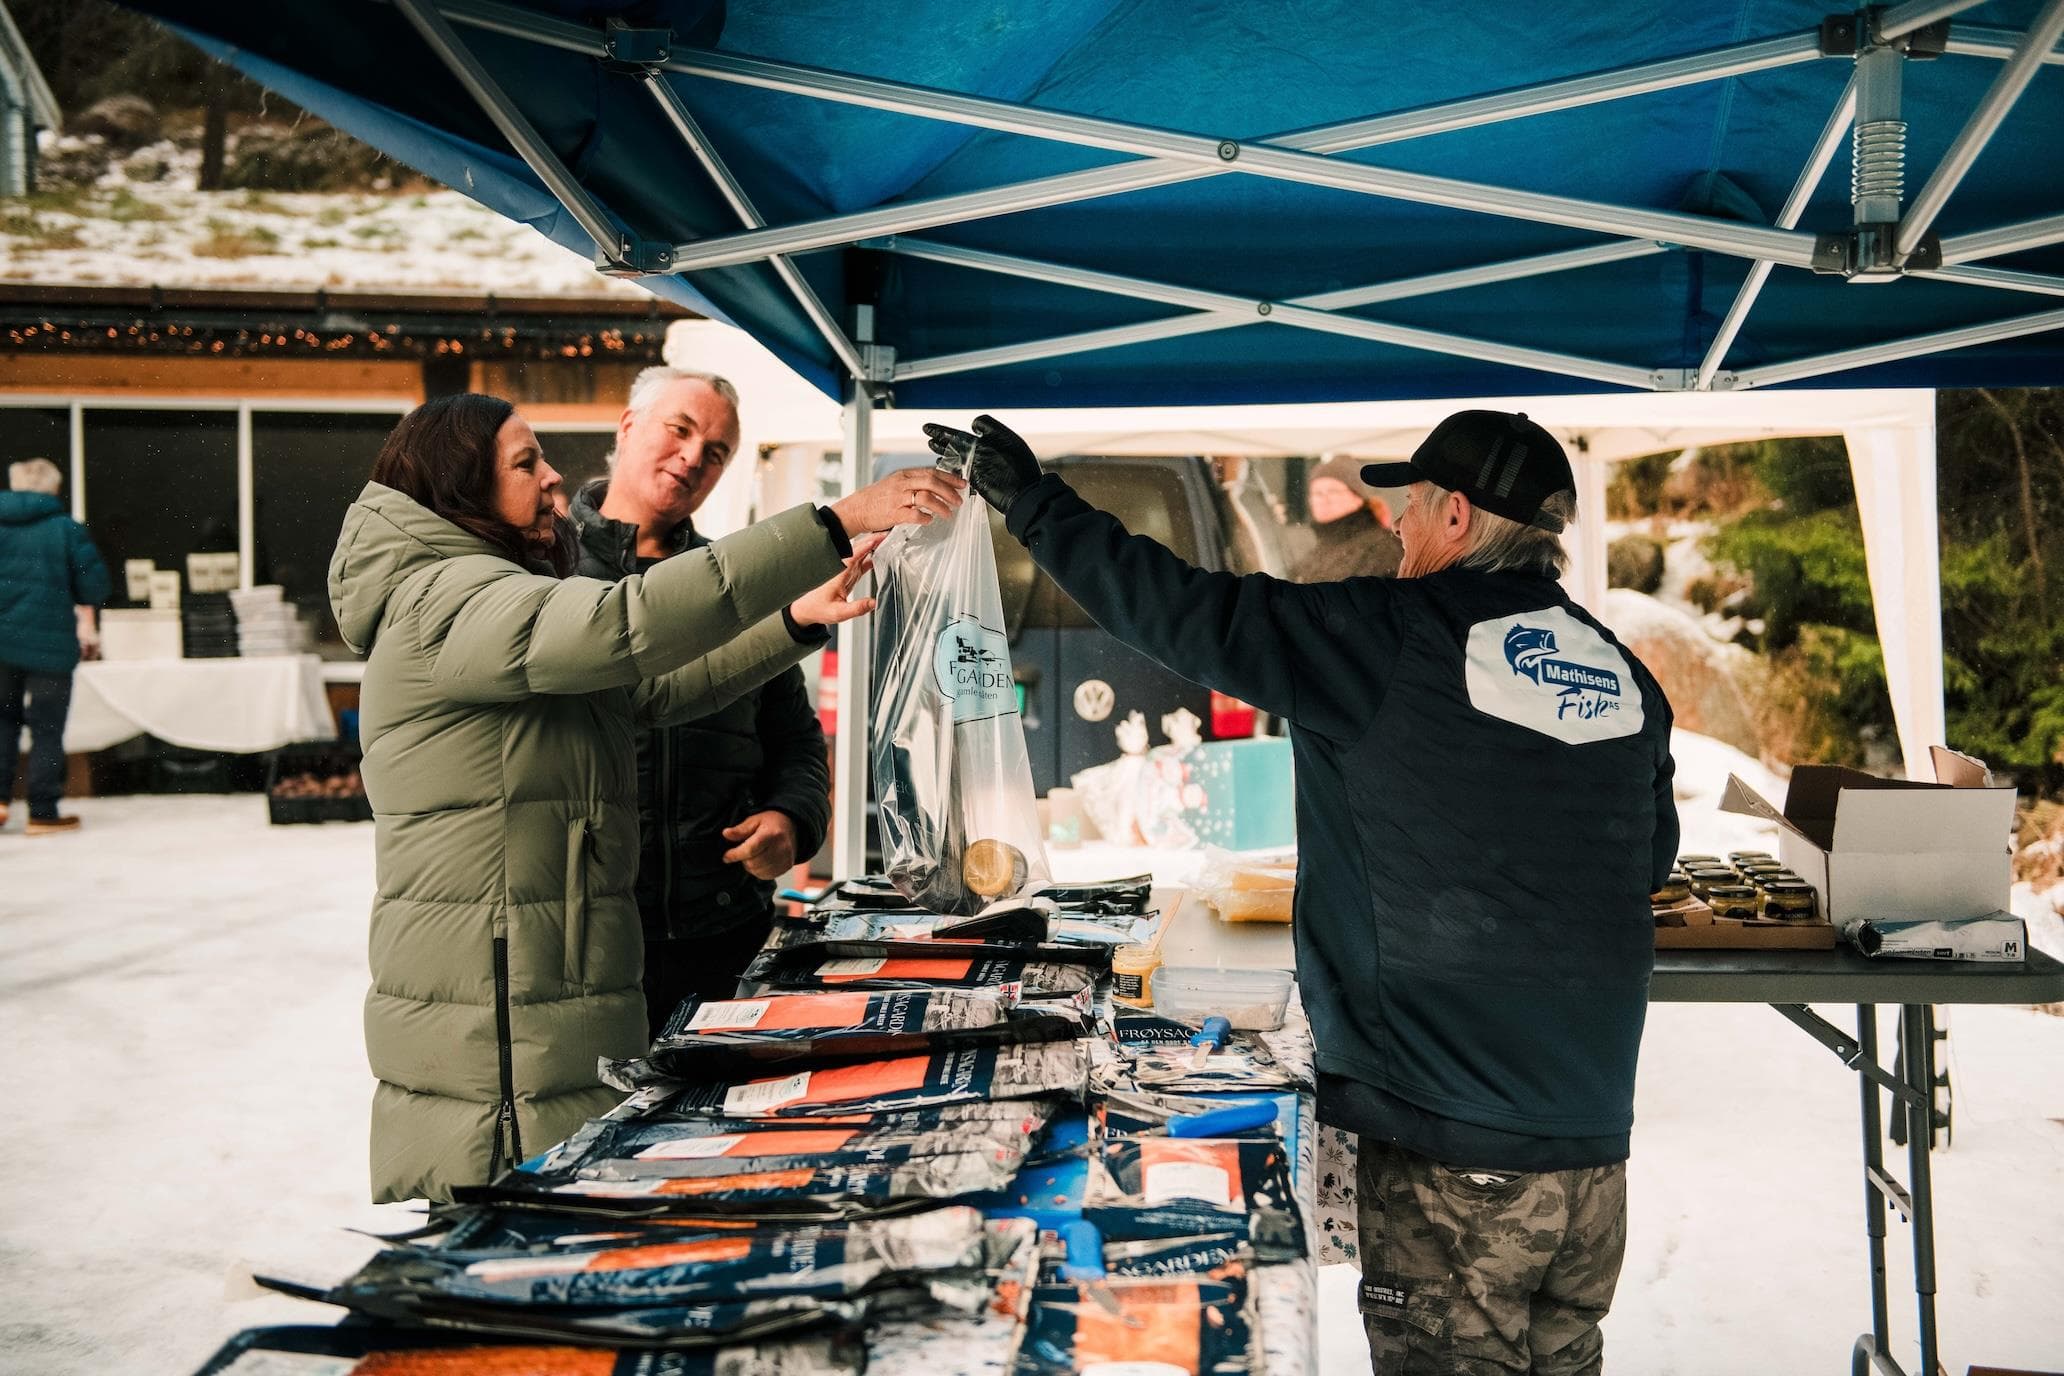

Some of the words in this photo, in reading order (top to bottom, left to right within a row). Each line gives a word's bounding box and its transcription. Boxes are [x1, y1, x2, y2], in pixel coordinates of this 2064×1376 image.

[957, 669, 1015, 689] GADEN
[1546, 664, 1617, 691] Mathisens
[1556, 686, 1610, 720] Fisk
[2004, 942, 2017, 953] M
